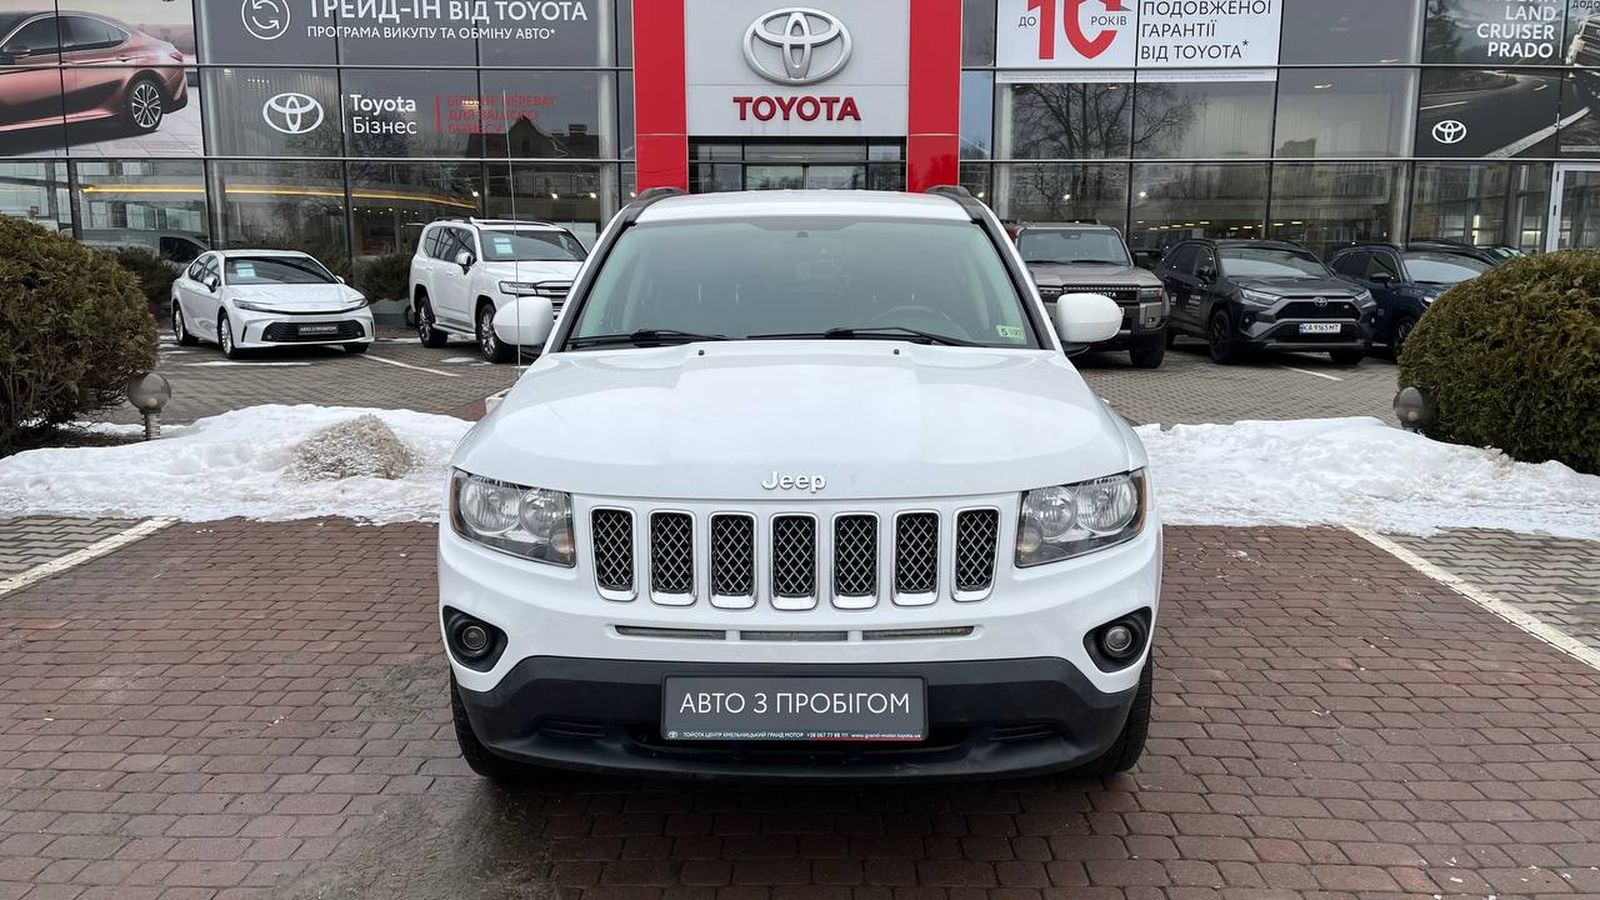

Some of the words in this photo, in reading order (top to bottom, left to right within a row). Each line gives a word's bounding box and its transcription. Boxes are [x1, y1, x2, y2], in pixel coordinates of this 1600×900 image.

[449, 1, 490, 24] ВІД
[495, 1, 588, 21] TOYOTA
[1018, 15, 1037, 27] ДО
[1090, 15, 1127, 27] РОКІВ
[1505, 5, 1556, 21] LAND
[308, 26, 381, 38] ПРОГРАМА
[383, 26, 437, 39] ВИКУПУ
[440, 27, 456, 39] ТА
[459, 27, 512, 39] ОБМІНУ
[1142, 19, 1217, 38] ГАРАНТІЇ
[1477, 23, 1555, 40] CRUISER
[1141, 45, 1168, 62] ВІД
[1487, 41, 1554, 58] PRADO
[349, 94, 416, 116] Toyota
[733, 96, 862, 121] TOYOTA
[353, 116, 417, 135] Бізнес
[761, 471, 826, 493] Jeep
[680, 692, 746, 714] АВТО
[753, 692, 768, 714] З
[776, 692, 911, 714] ПРОБІГОМ
